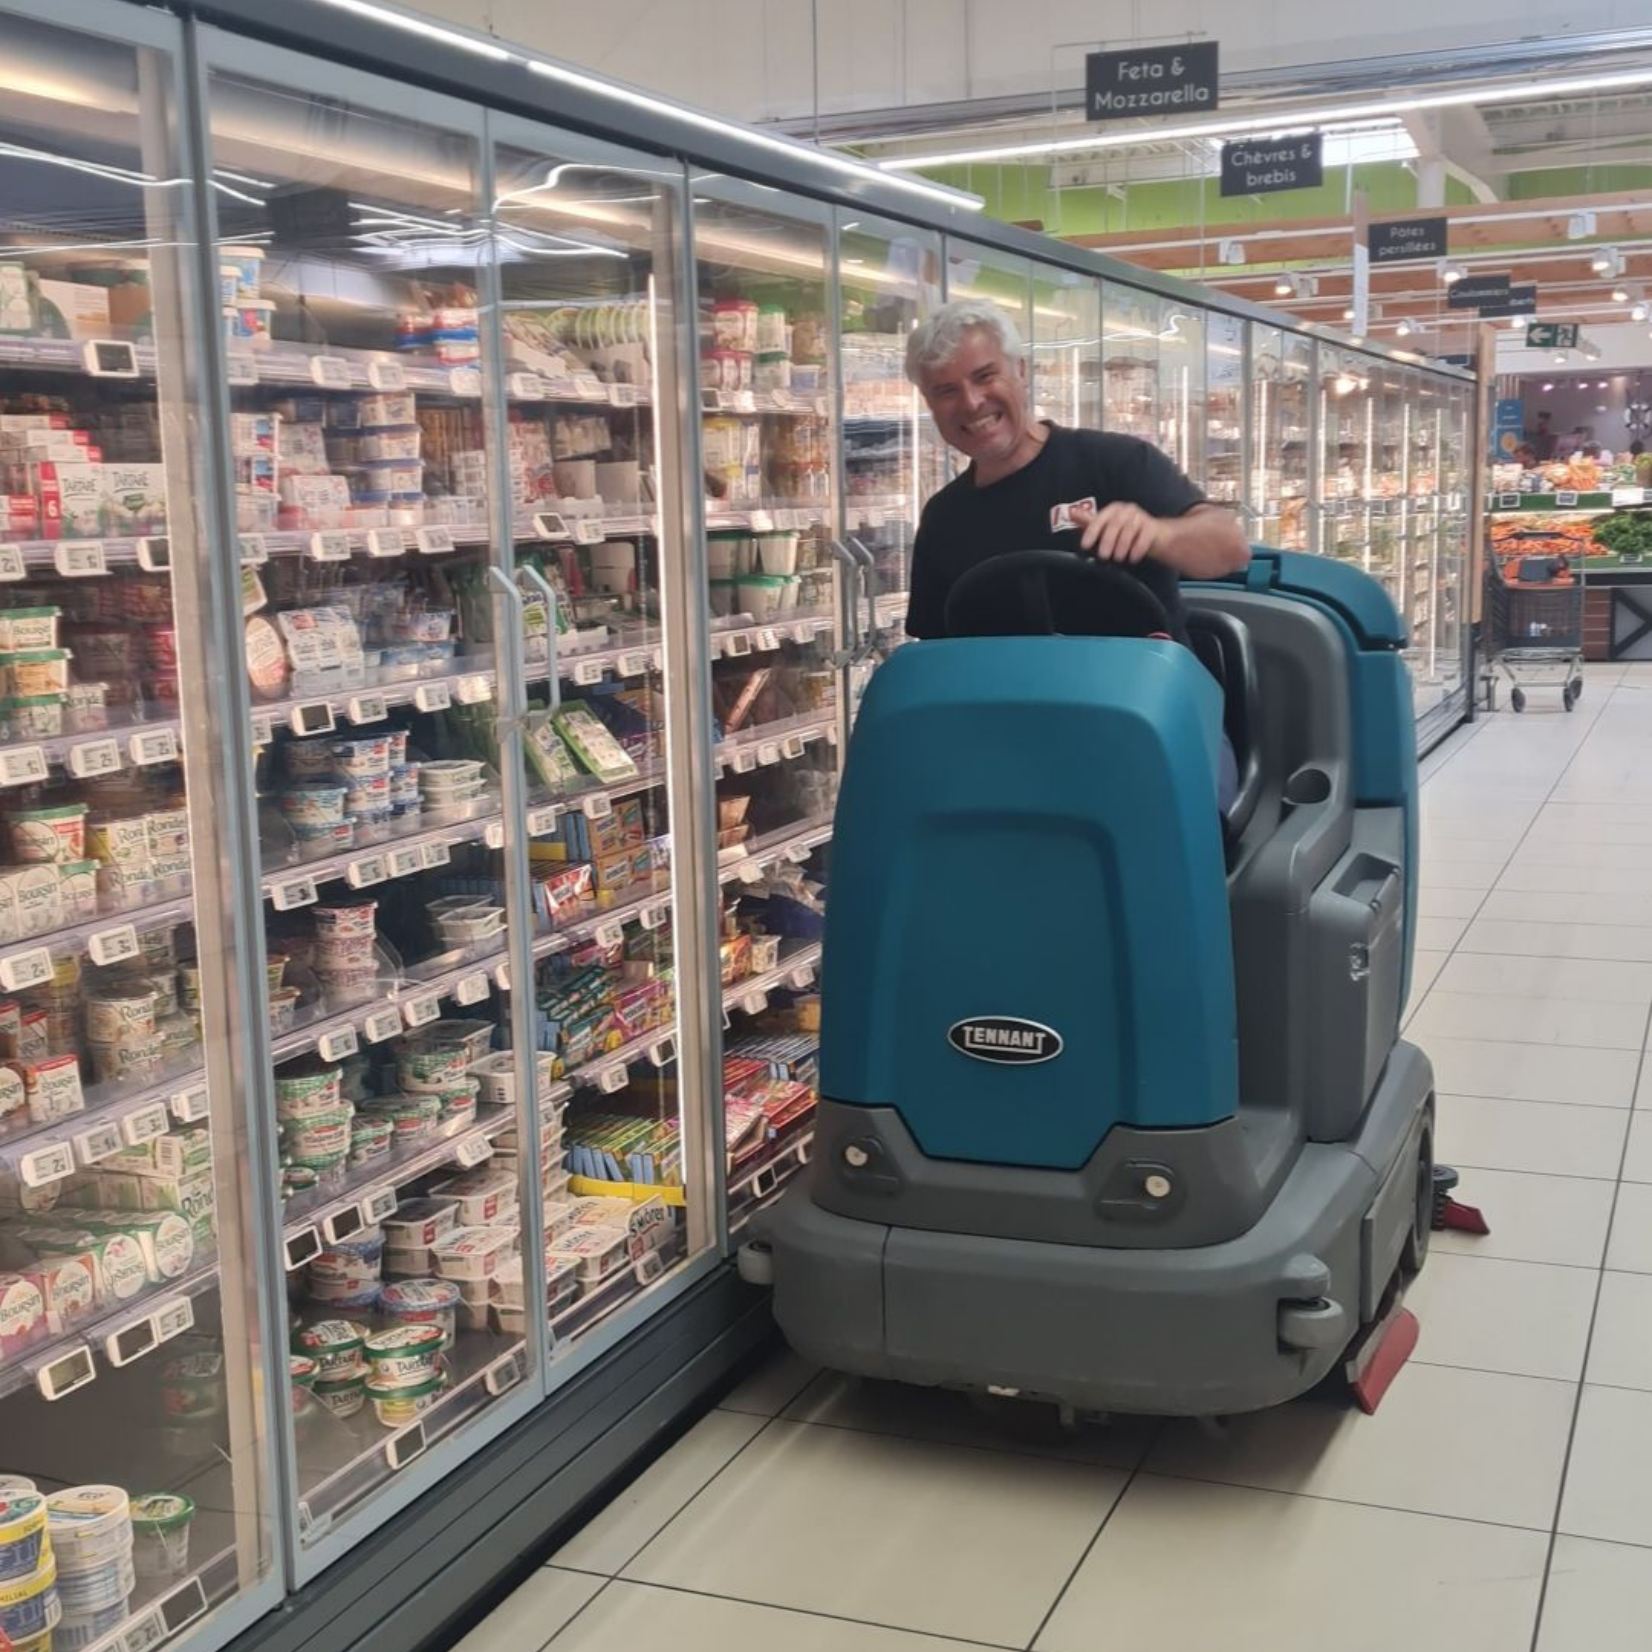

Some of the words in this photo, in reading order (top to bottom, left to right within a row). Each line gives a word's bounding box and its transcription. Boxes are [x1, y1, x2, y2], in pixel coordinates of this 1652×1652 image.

[1118, 61, 1164, 81] Feta
[1171, 56, 1186, 76] &
[1094, 83, 1209, 110] Mozzarella
[1231, 149, 1296, 166] Chèvres
[1301, 143, 1313, 159] &
[1246, 168, 1297, 186] brebis
[48, 499, 57, 518] 6
[962, 1026, 1046, 1054] TENNANT
